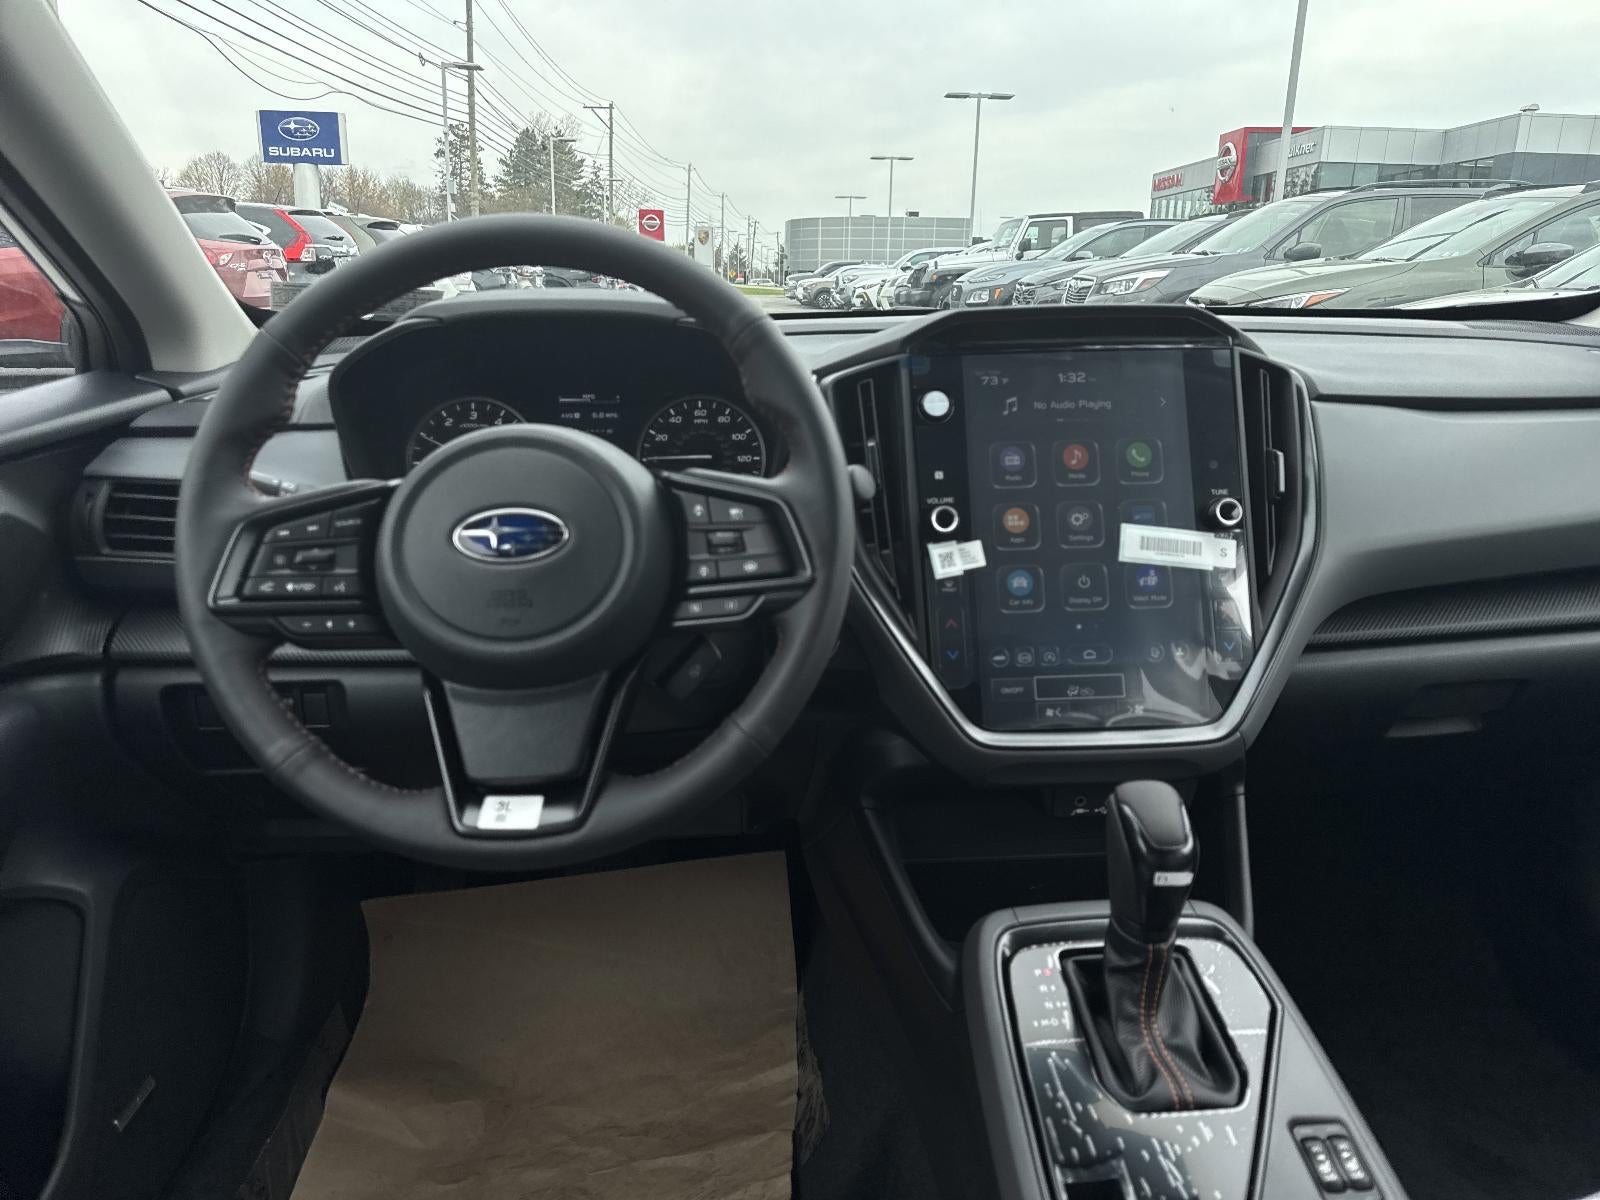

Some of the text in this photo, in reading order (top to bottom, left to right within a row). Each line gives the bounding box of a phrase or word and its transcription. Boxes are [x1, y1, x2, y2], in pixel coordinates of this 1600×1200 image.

[268, 146, 335, 158] SUBARU
[981, 375, 999, 386] 73
[1057, 371, 1087, 384] 1:32
[1033, 399, 1112, 411] No Audio Playing
[469, 411, 478, 421] 3
[693, 408, 708, 417] 60
[443, 417, 453, 427] 2
[669, 415, 682, 424] 40
[717, 415, 731, 424] 80
[654, 433, 668, 442] 20
[731, 432, 747, 441] 100
[736, 454, 753, 463] 120
[1211, 488, 1229, 496] TUNE
[926, 496, 955, 505] VOLUME
[1220, 547, 1228, 558] S
